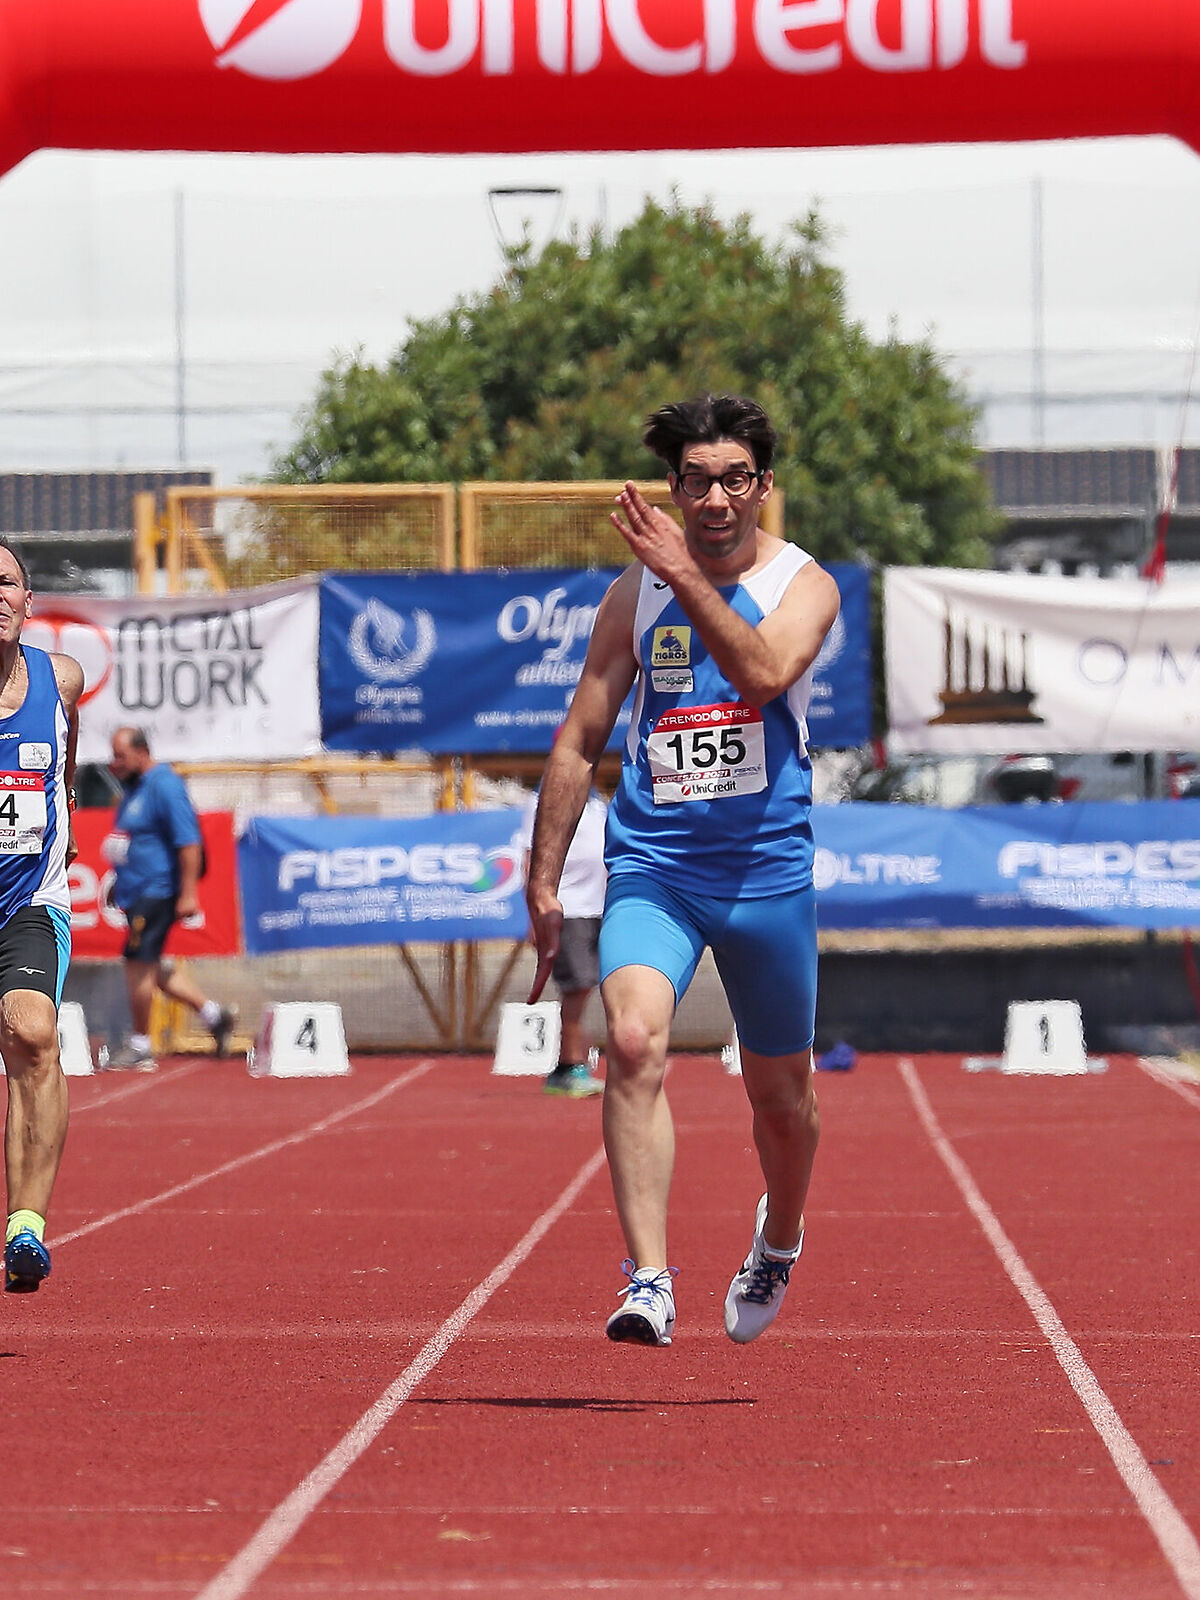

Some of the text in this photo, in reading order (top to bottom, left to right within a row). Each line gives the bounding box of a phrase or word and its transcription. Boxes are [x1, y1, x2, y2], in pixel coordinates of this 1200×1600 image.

[654, 651, 688, 660] TIGROS
[116, 660, 268, 710] WORK
[658, 708, 751, 727] LTREMODOLTRE
[666, 727, 747, 771] 155
[656, 770, 729, 784] CONCESIO 2021
[692, 781, 737, 794] UniCredit
[278, 843, 486, 892] FISPES
[998, 840, 1200, 880] FISPES
[295, 1016, 318, 1054] 4
[522, 1012, 547, 1053] 3
[1038, 1013, 1052, 1056] 1
